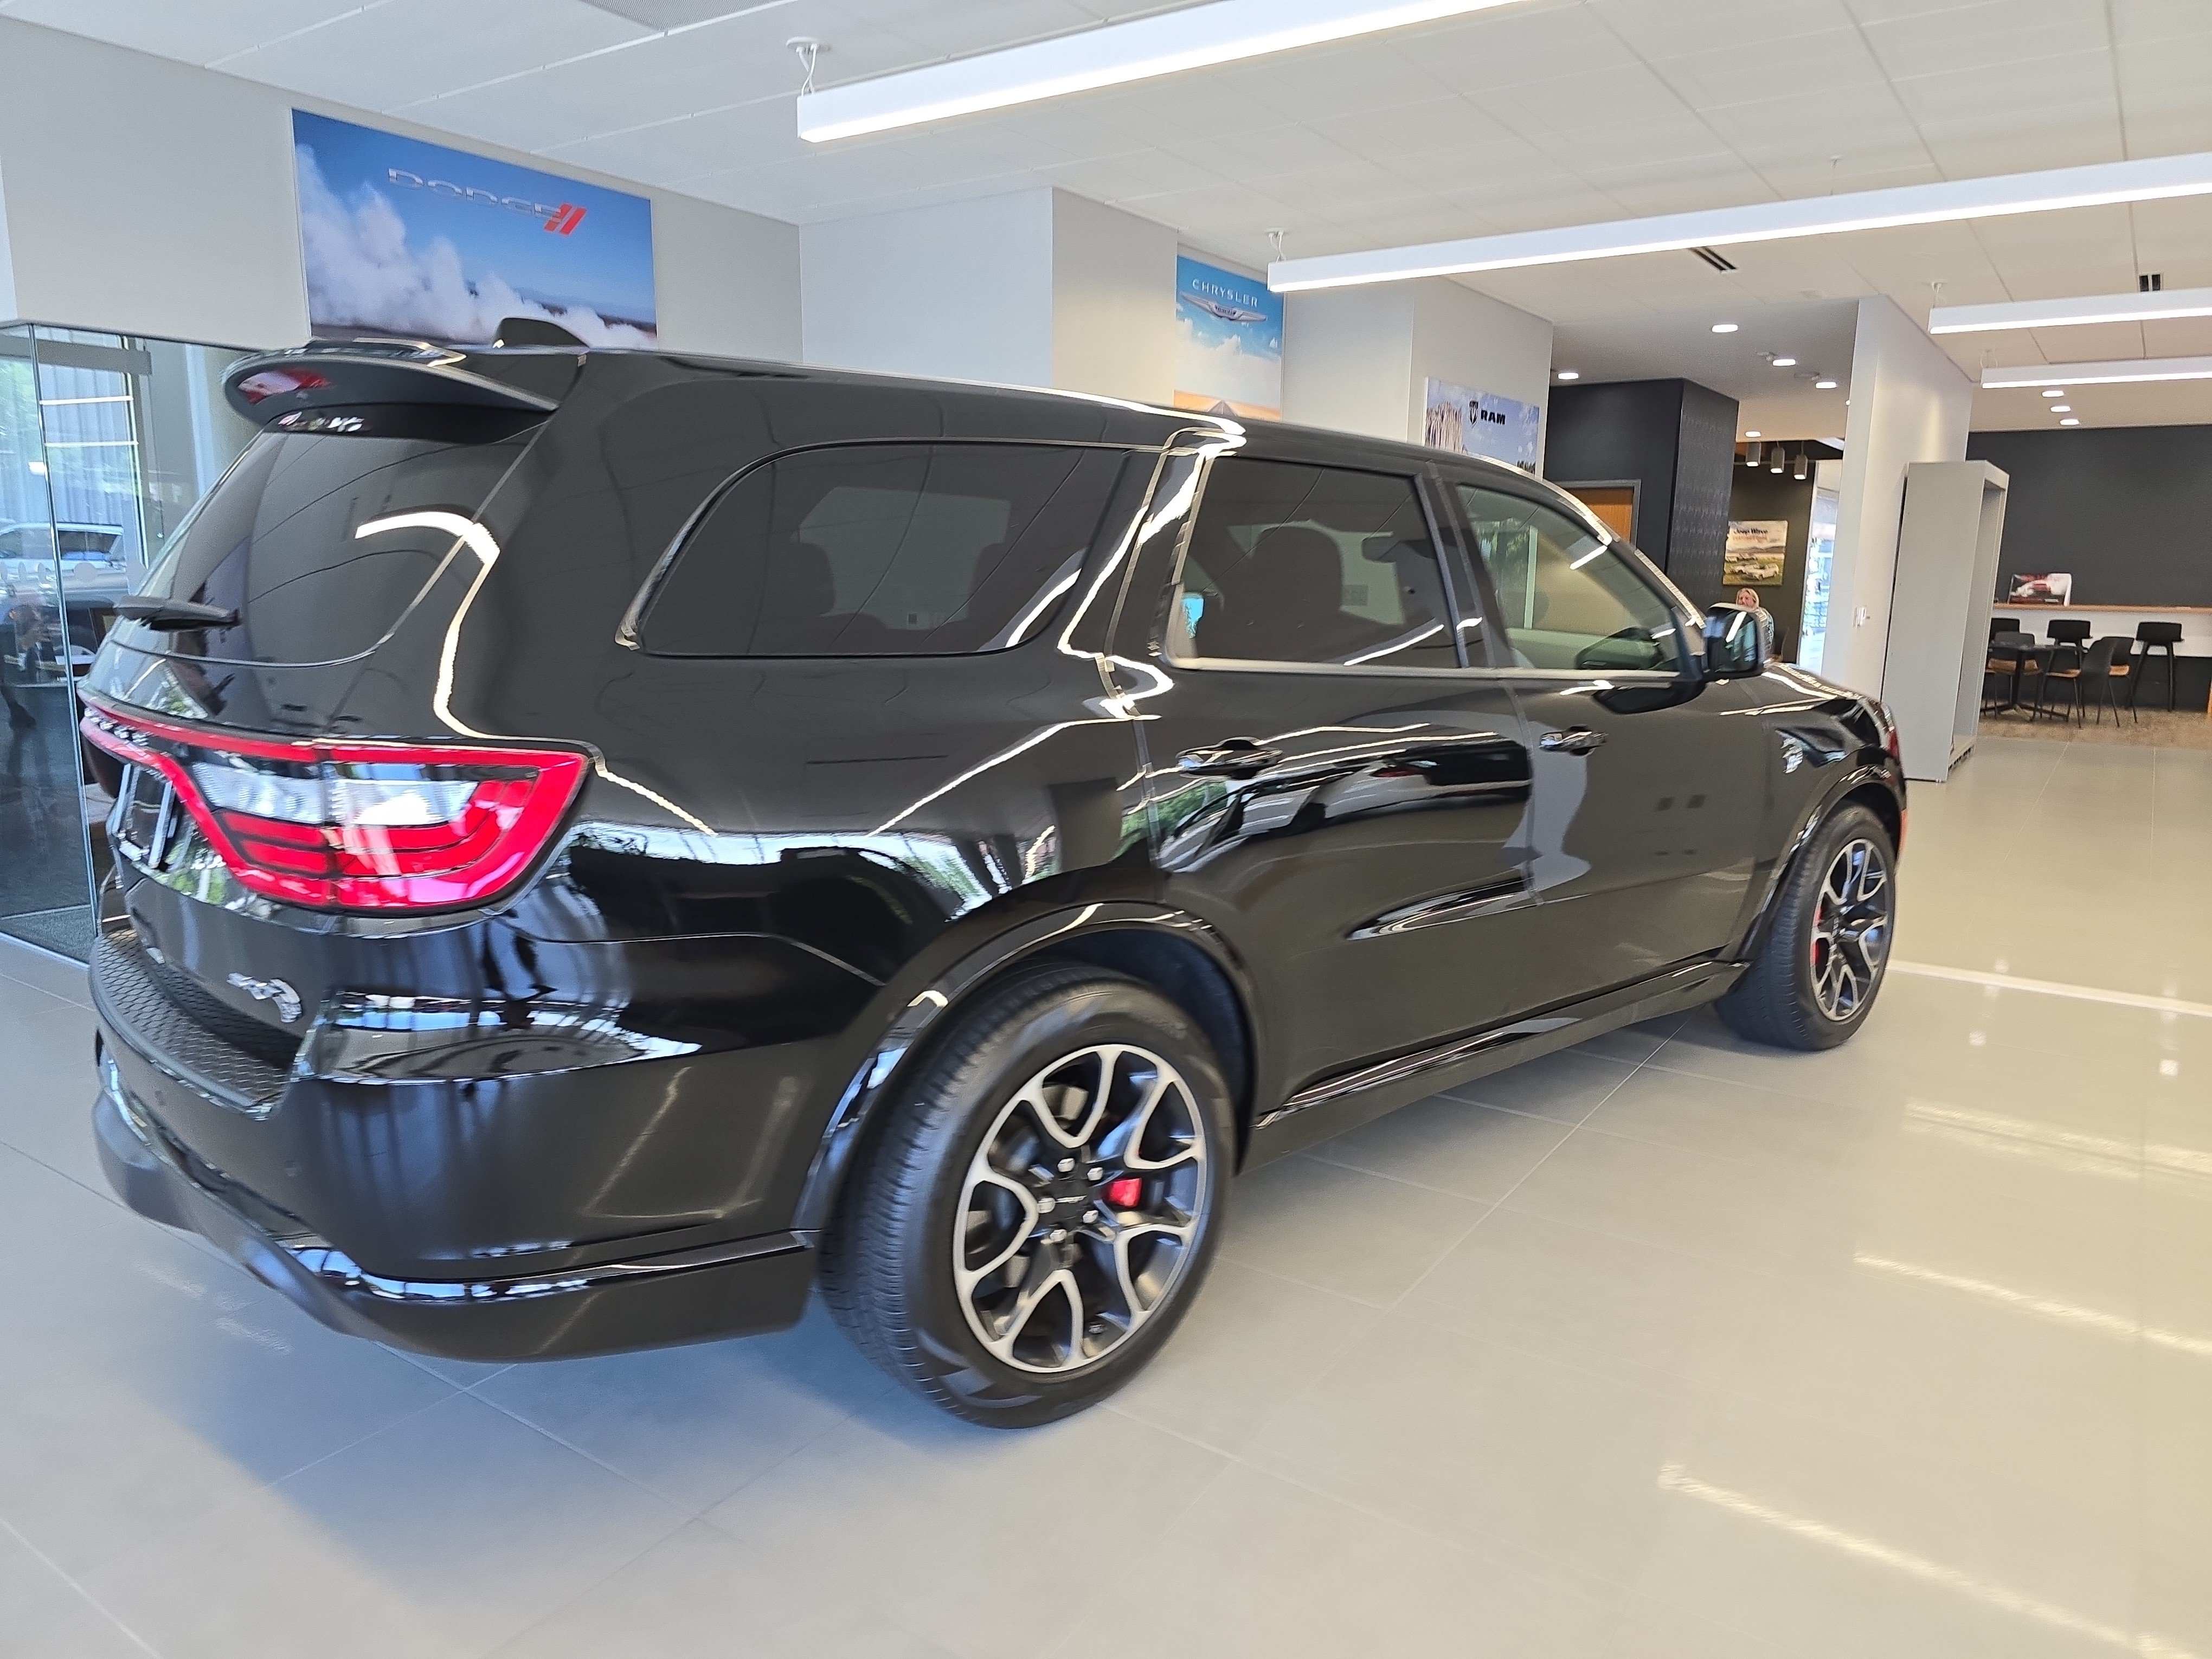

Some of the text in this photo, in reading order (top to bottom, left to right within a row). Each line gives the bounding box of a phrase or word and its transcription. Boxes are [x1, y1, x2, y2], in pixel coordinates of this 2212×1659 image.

[388, 168, 562, 221] DODGE
[1192, 278, 1258, 307] CHRYSLER
[1481, 409, 1506, 425] RAM
